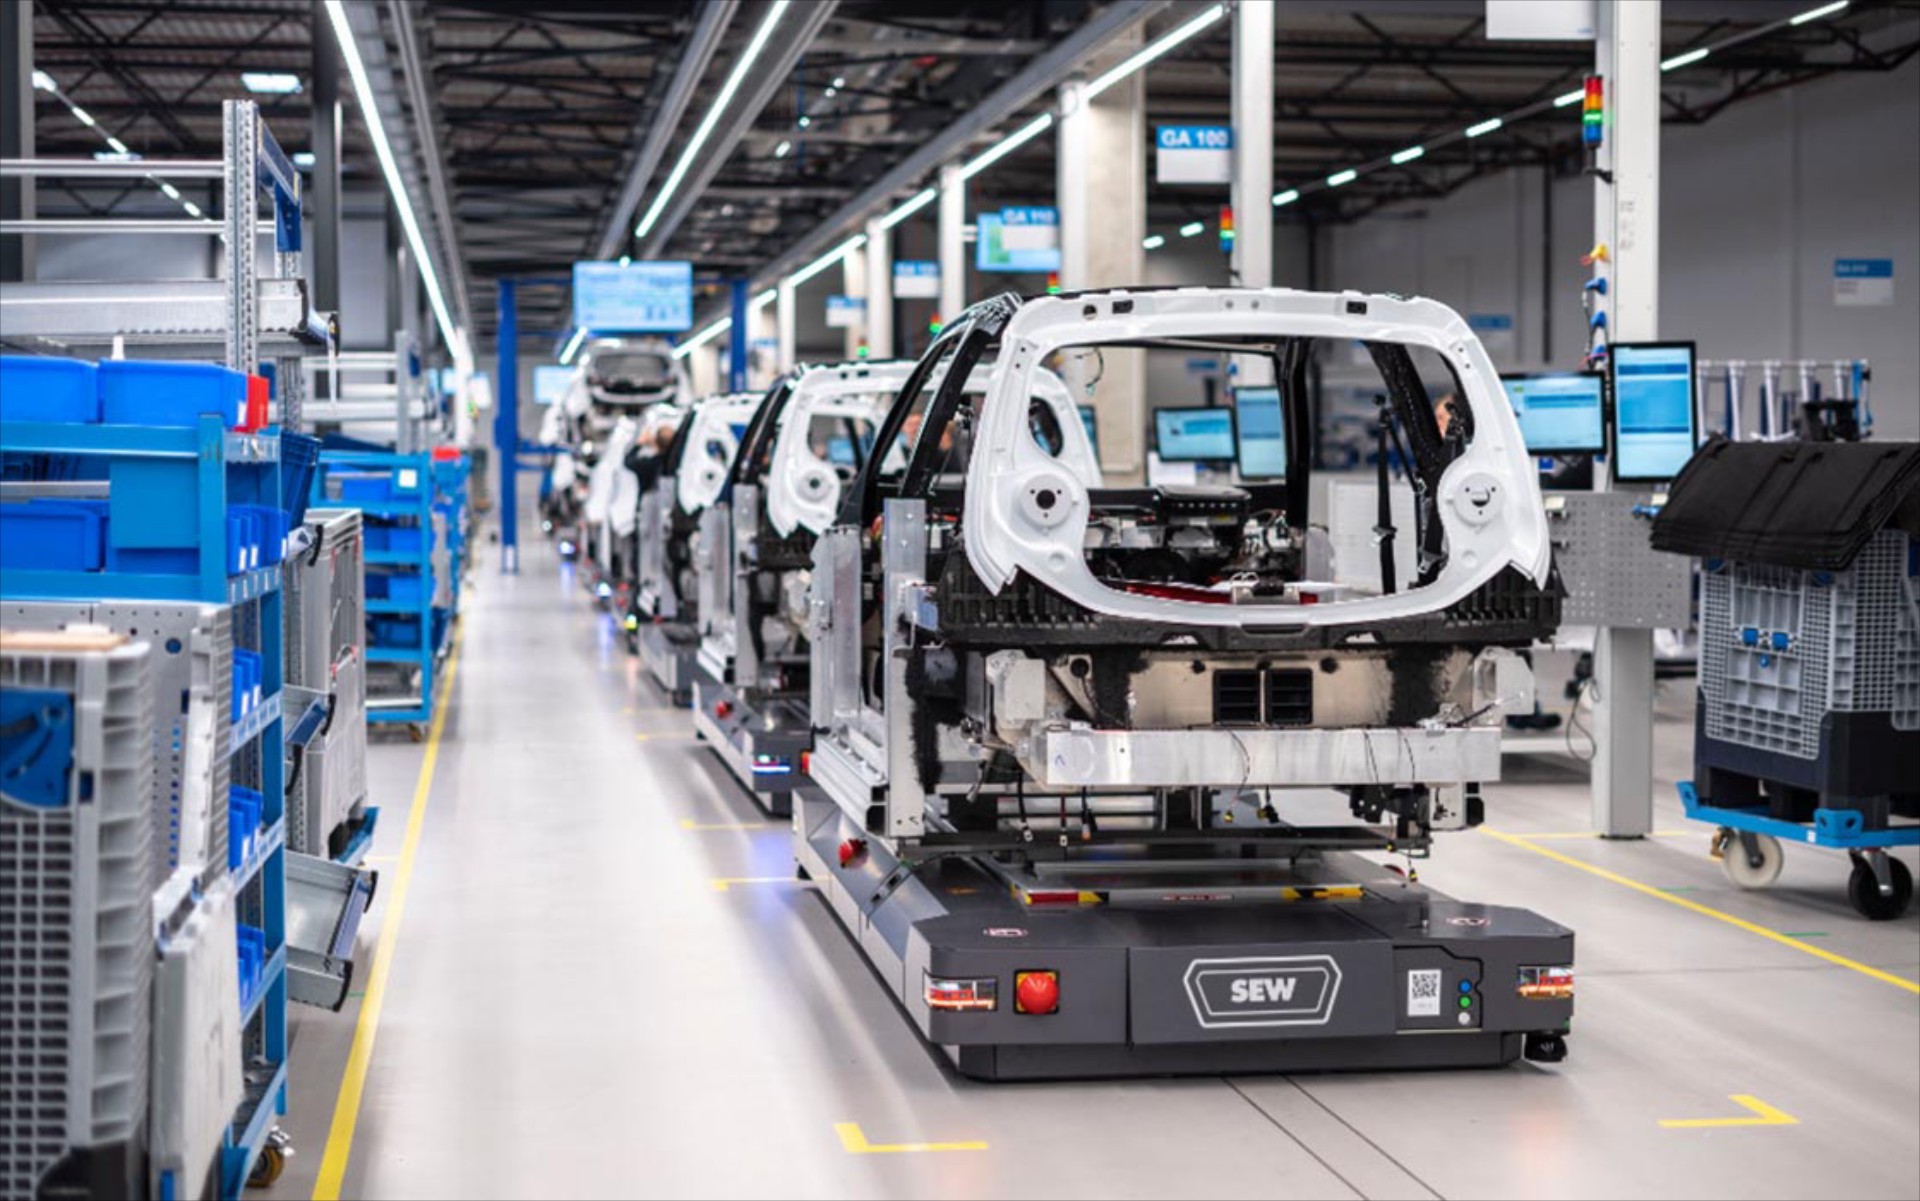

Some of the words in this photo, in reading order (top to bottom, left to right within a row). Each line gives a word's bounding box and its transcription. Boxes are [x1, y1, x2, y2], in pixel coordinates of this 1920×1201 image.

[1161, 129, 1191, 147] GA
[1196, 129, 1229, 147] 100
[1231, 977, 1297, 1003] SEW
